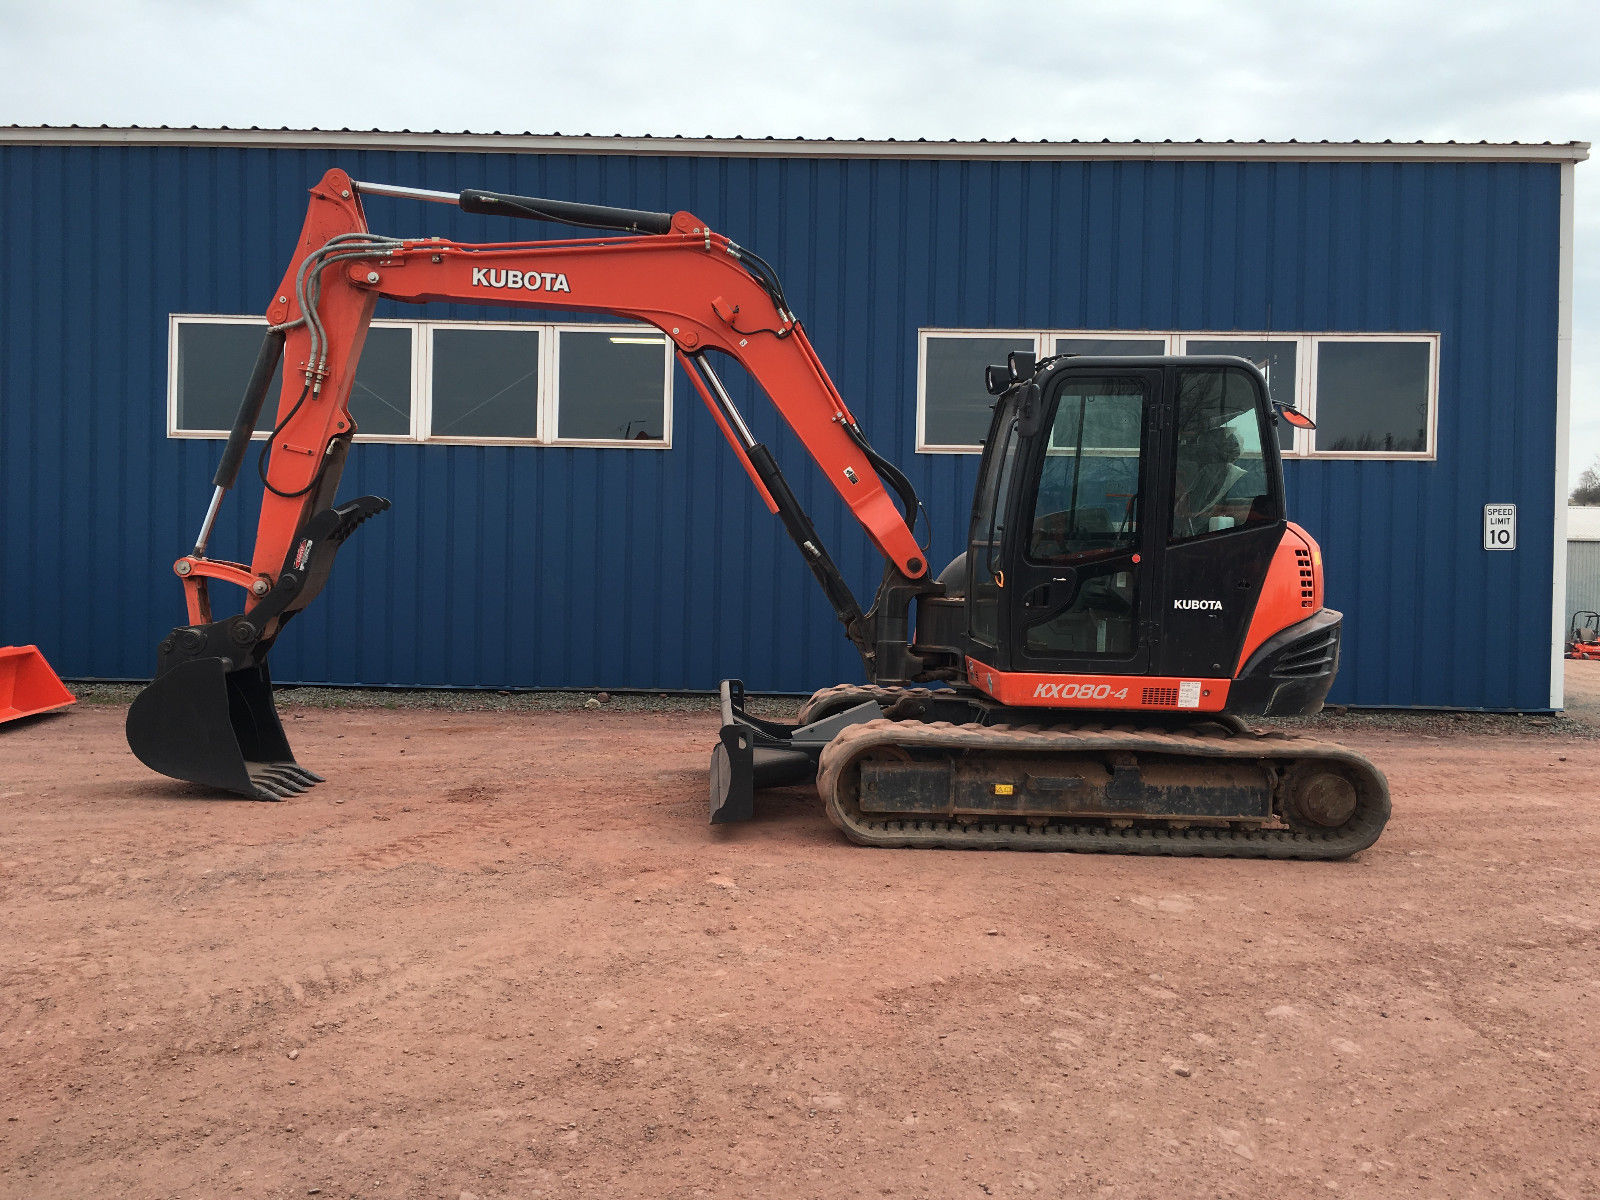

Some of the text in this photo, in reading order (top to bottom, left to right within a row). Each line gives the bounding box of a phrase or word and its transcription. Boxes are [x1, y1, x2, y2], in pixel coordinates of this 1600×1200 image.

[472, 267, 571, 293] KUBOTA
[1487, 508, 1513, 516] SPEED
[1490, 517, 1511, 525] LIMIT
[1490, 529, 1511, 545] 10
[1173, 599, 1223, 610] KUBOTA
[1033, 683, 1129, 700] KX080-4
